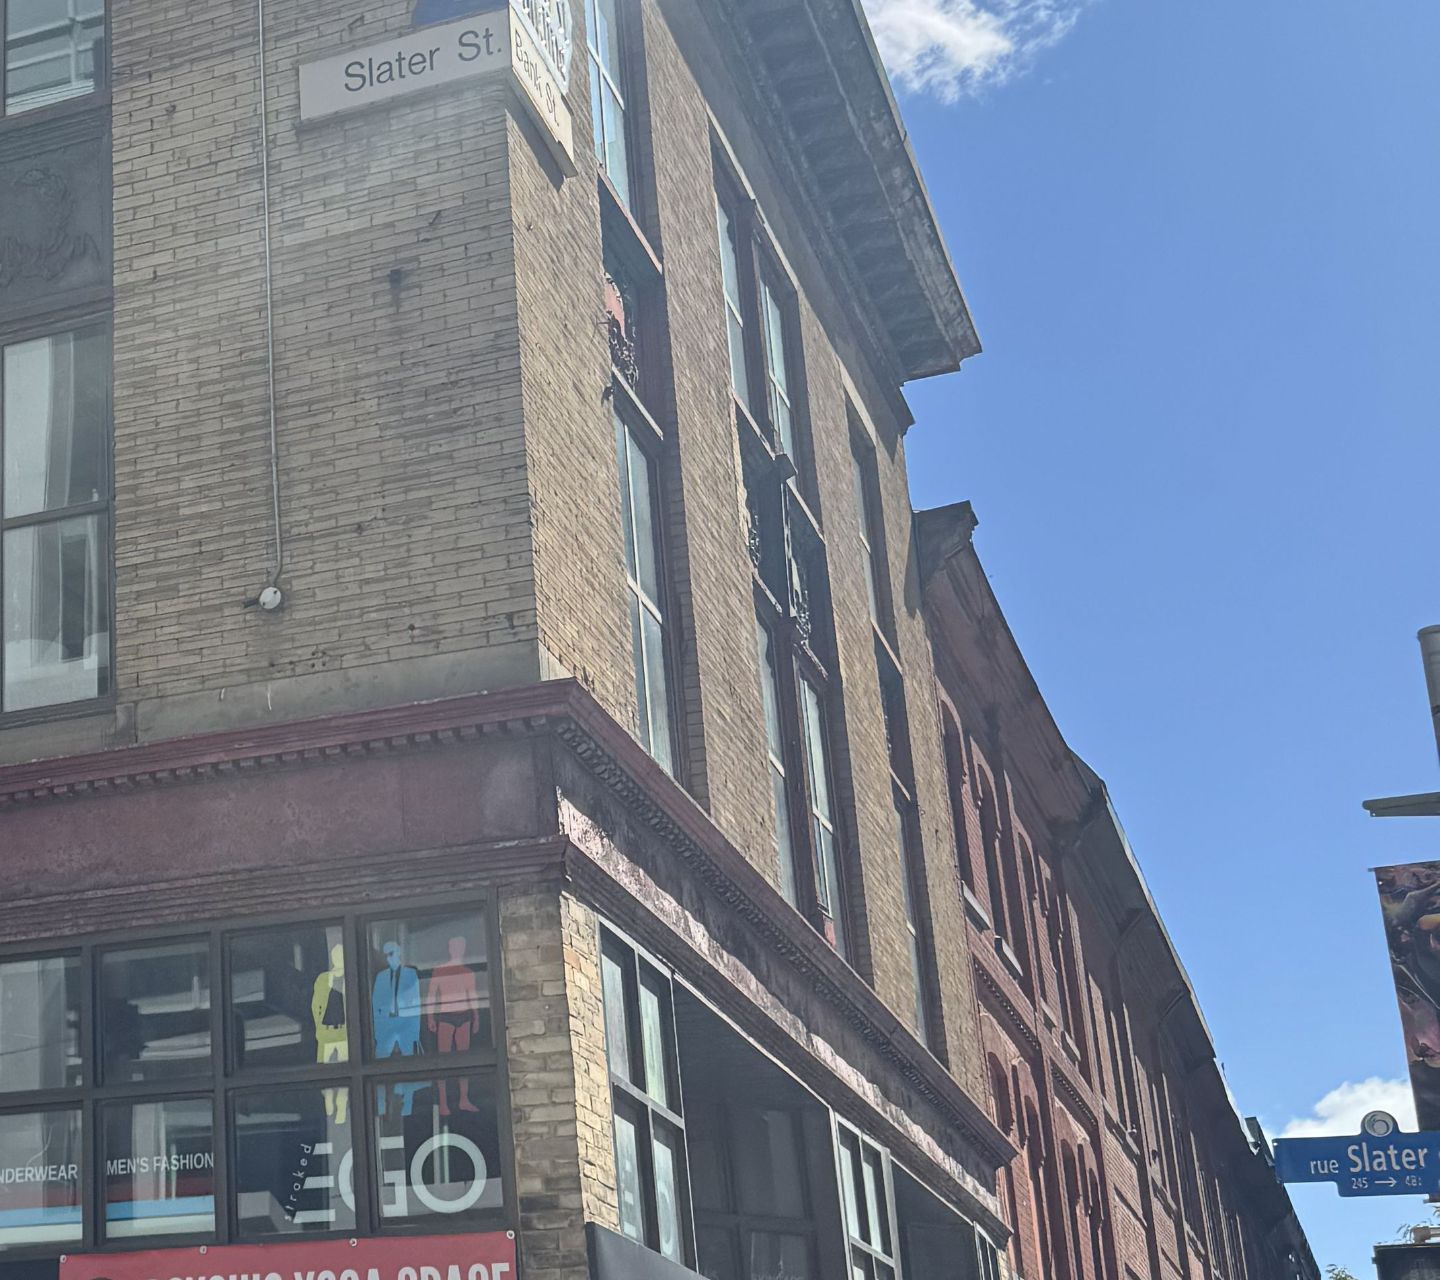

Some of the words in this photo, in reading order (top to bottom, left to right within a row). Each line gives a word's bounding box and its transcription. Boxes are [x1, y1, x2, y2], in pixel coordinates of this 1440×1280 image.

[344, 44, 441, 93] Slater
[457, 26, 503, 63] St.
[515, 30, 543, 93] Bank
[106, 1156, 150, 1176] MEN'S
[154, 1152, 214, 1173] FASHION
[1310, 1158, 1339, 1174] rue
[1347, 1141, 1428, 1173] Slater
